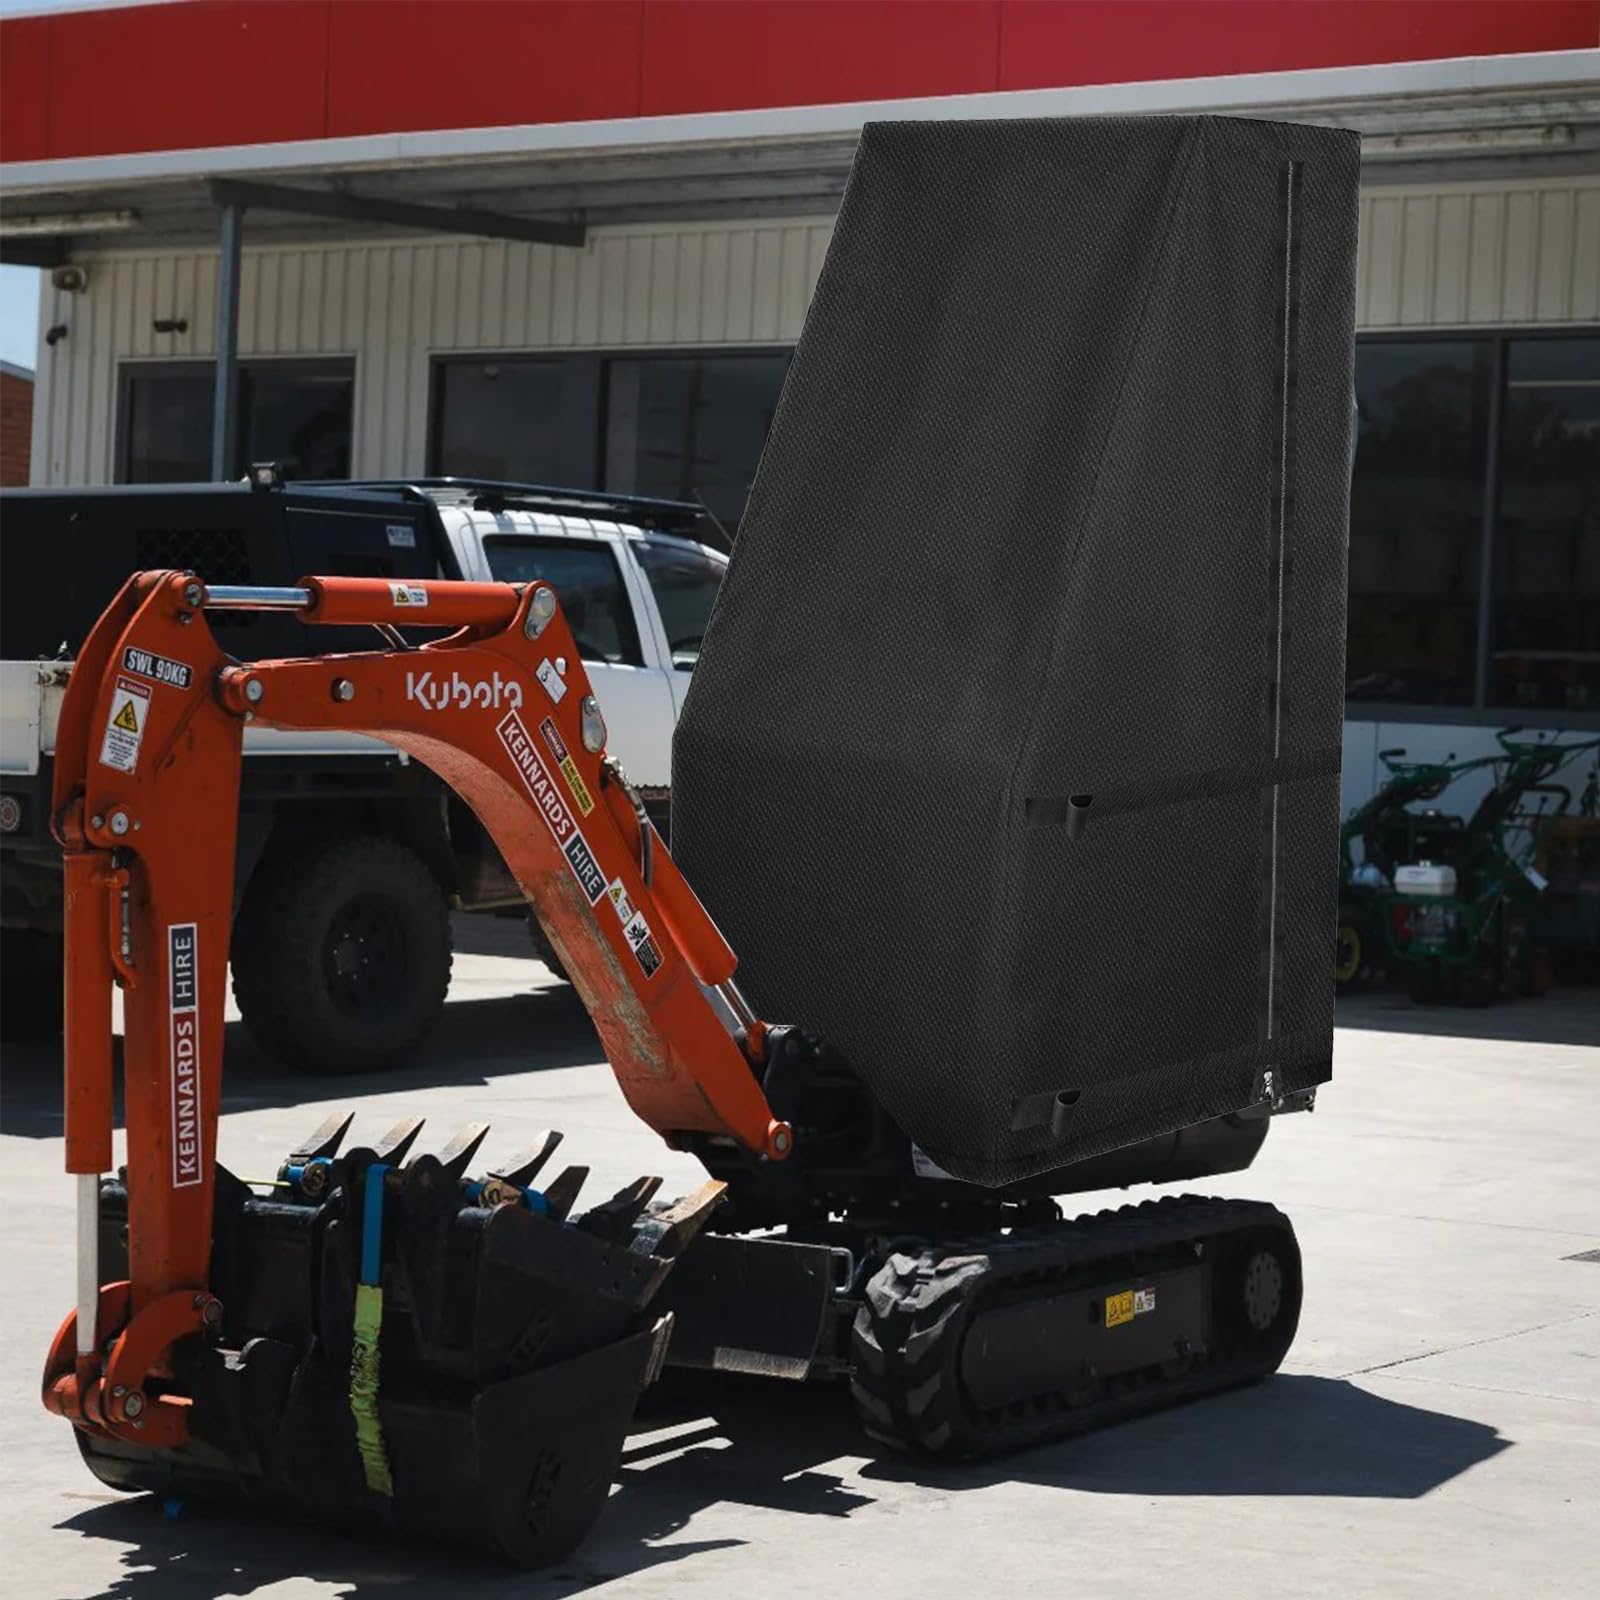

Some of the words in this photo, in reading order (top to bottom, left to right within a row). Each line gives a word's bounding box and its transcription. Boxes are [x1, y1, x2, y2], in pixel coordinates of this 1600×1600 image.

[128, 650, 154, 675] SWL
[156, 660, 188, 686] 90KG
[406, 671, 523, 710] Kubota
[504, 721, 571, 836] KENNARDS
[570, 842, 601, 894] HIRE
[175, 936, 192, 998] HIRE
[177, 1020, 196, 1174] KENNARDS
